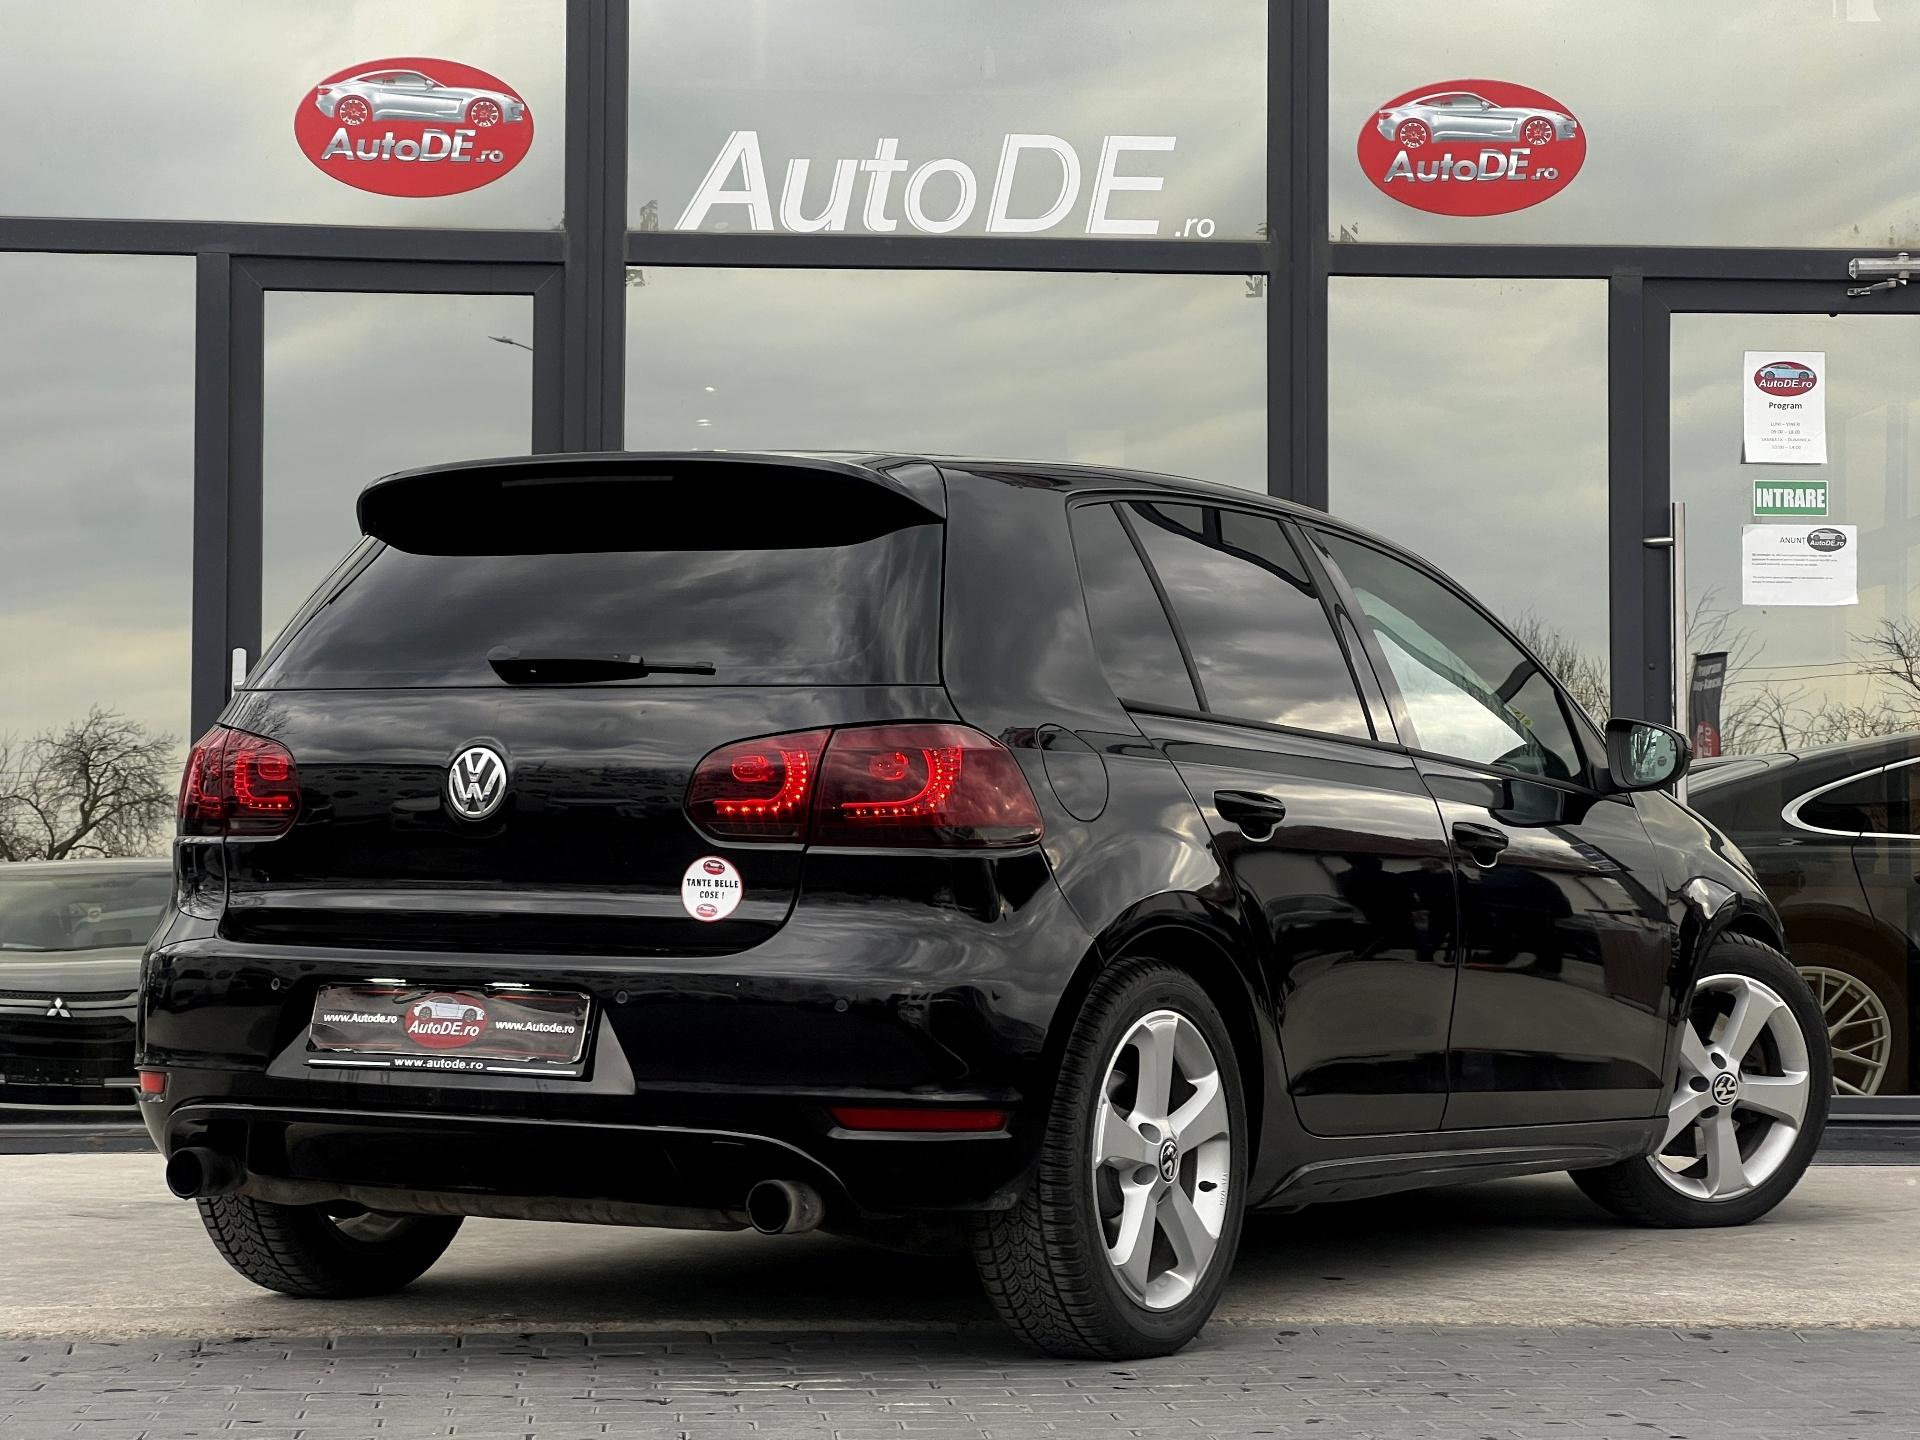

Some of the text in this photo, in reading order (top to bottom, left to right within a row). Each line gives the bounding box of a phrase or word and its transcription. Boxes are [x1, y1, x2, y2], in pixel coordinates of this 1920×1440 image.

[1759, 379, 1813, 388] AutoDE.ro
[1768, 402, 1802, 410] Program
[1756, 488, 1826, 508] INTRARE
[686, 878, 739, 888] TANTE BELLE
[699, 890, 719, 899] COSE
[323, 1013, 398, 1024] www.Autode.ro
[408, 1020, 480, 1037] AutoDE.ro
[495, 1020, 575, 1034] www.Autode.ro
[394, 1057, 483, 1070] www.autode.ro
